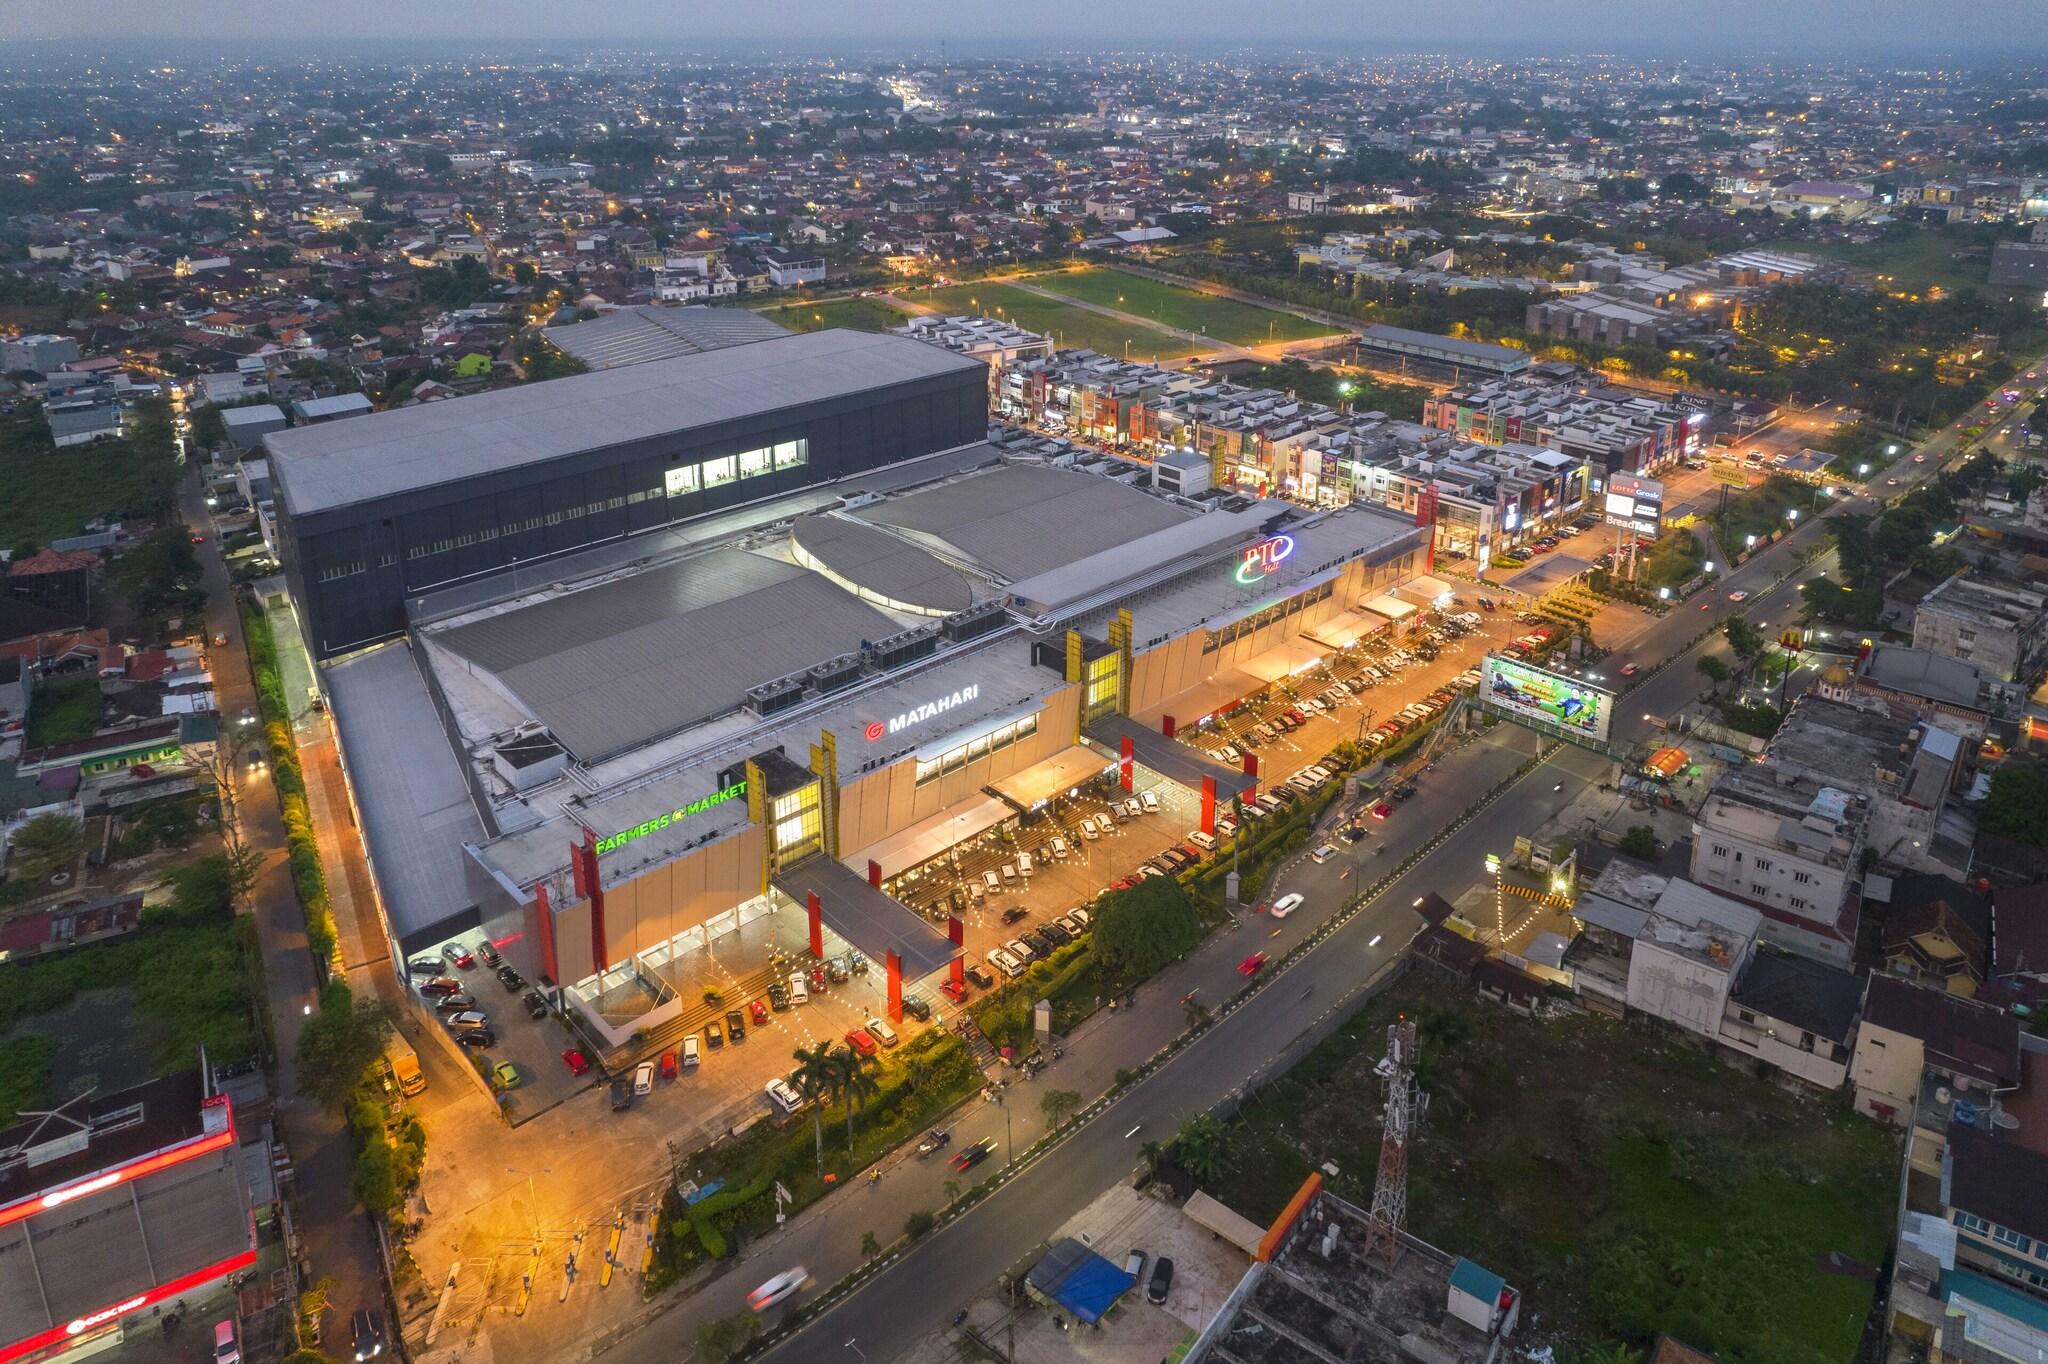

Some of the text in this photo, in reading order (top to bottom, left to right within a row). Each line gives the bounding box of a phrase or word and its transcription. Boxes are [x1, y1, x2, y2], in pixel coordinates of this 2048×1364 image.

[1681, 395, 1707, 405] KING
[1611, 484, 1634, 493] LOTTE
[1606, 515, 1656, 533] BreadTalk
[1245, 539, 1283, 573] PTC
[889, 684, 978, 733] MATAHARI
[595, 781, 747, 855] FARMERS MARKET
